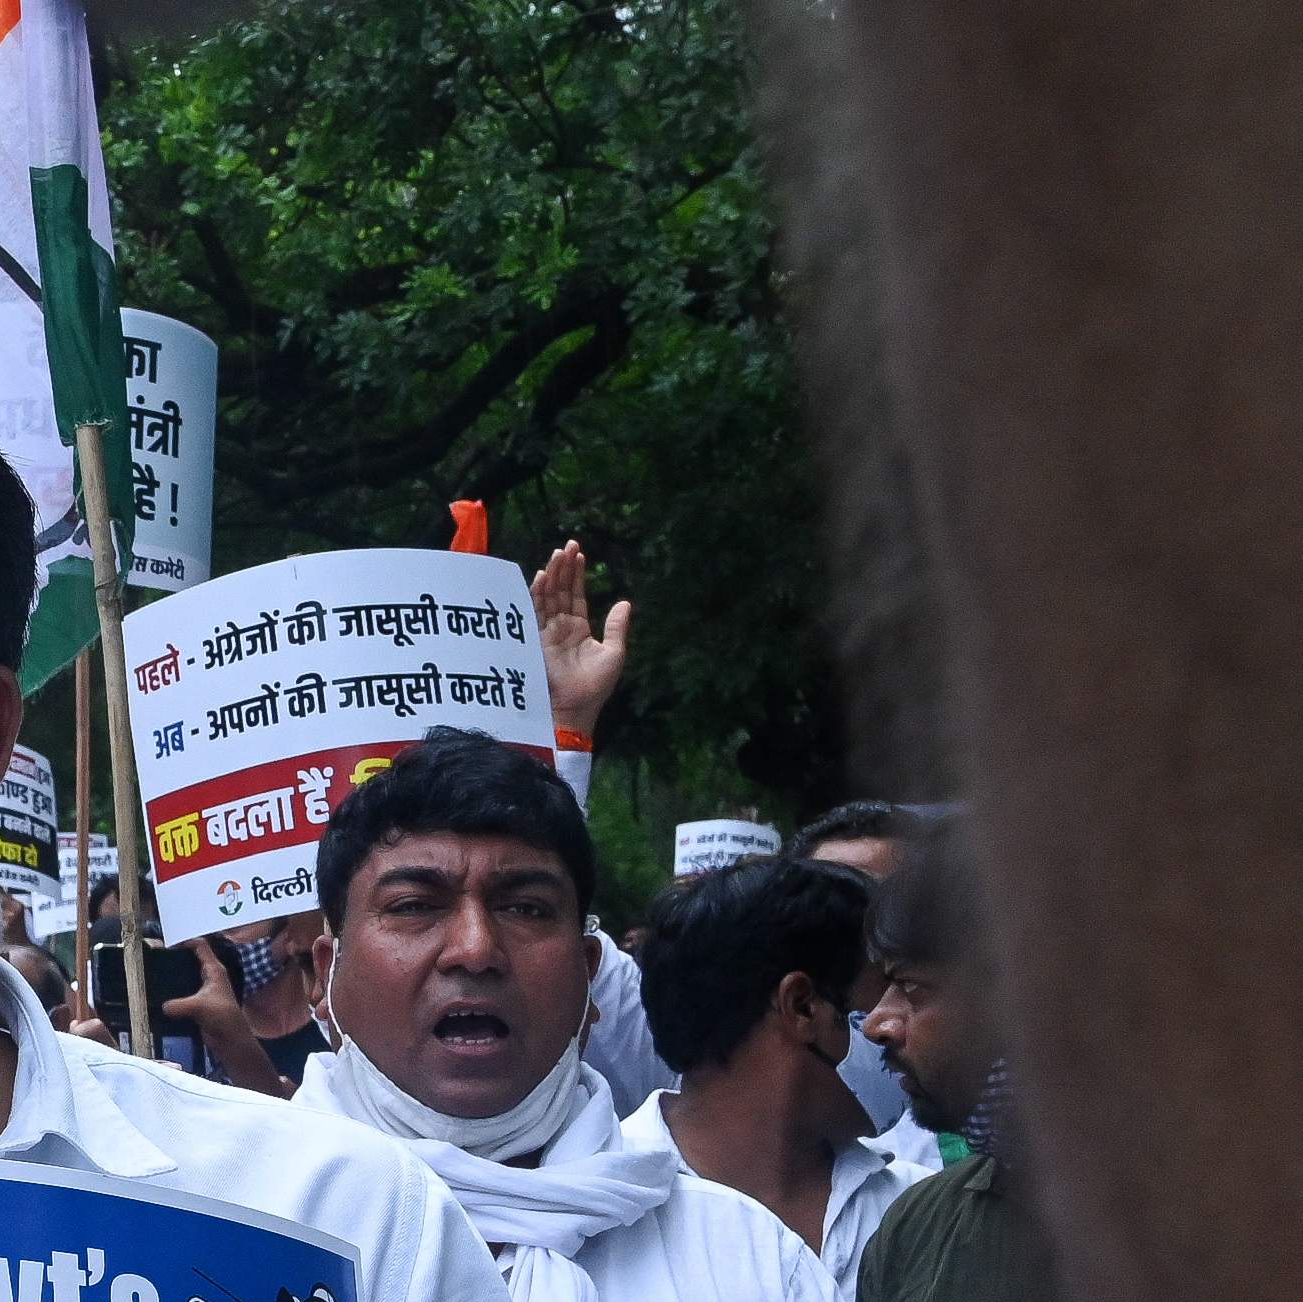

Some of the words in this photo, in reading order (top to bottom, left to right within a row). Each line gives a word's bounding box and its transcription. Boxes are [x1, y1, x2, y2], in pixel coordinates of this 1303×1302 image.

[134, 643, 180, 696] पहले
[202, 610, 280, 671] अंग्रेजों
[283, 599, 328, 647] की
[332, 593, 439, 648] जासूसी
[442, 599, 502, 641] करते
[505, 603, 525, 645] थे
[152, 721, 185, 760] अब
[206, 682, 280, 741] अपनों
[283, 672, 328, 719] की
[332, 662, 443, 718] जासूसी
[446, 665, 506, 708] करते
[506, 667, 527, 712] हैं
[154, 811, 201, 865] वक्त
[201, 786, 296, 848] बदला
[296, 766, 335, 826] हैं
[251, 867, 314, 905] दिल्ली
